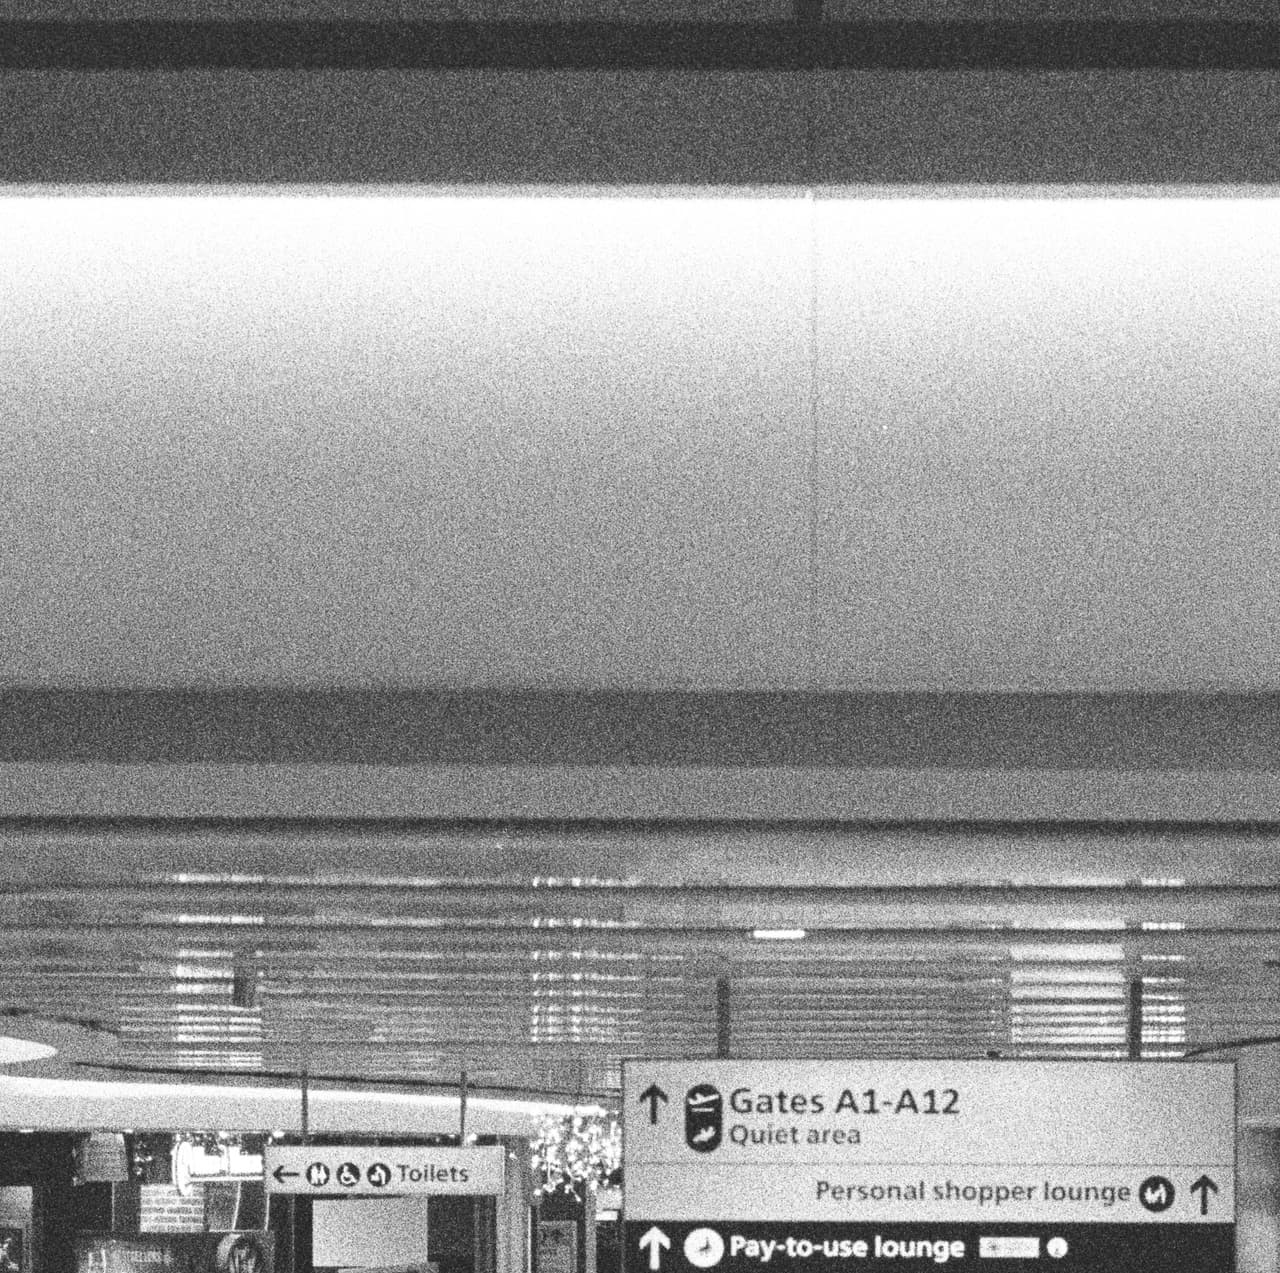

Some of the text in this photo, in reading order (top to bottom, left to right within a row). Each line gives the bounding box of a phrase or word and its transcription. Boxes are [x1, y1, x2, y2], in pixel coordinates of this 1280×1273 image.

[729, 1087, 961, 1115] Gates A1-A12
[729, 1124, 862, 1149] Quiet area
[396, 1164, 469, 1183] Toilets
[816, 1180, 1132, 1206] Personal shopper lounge
[729, 1235, 868, 1263] Pay-to-use
[875, 1235, 965, 1263] lounge
